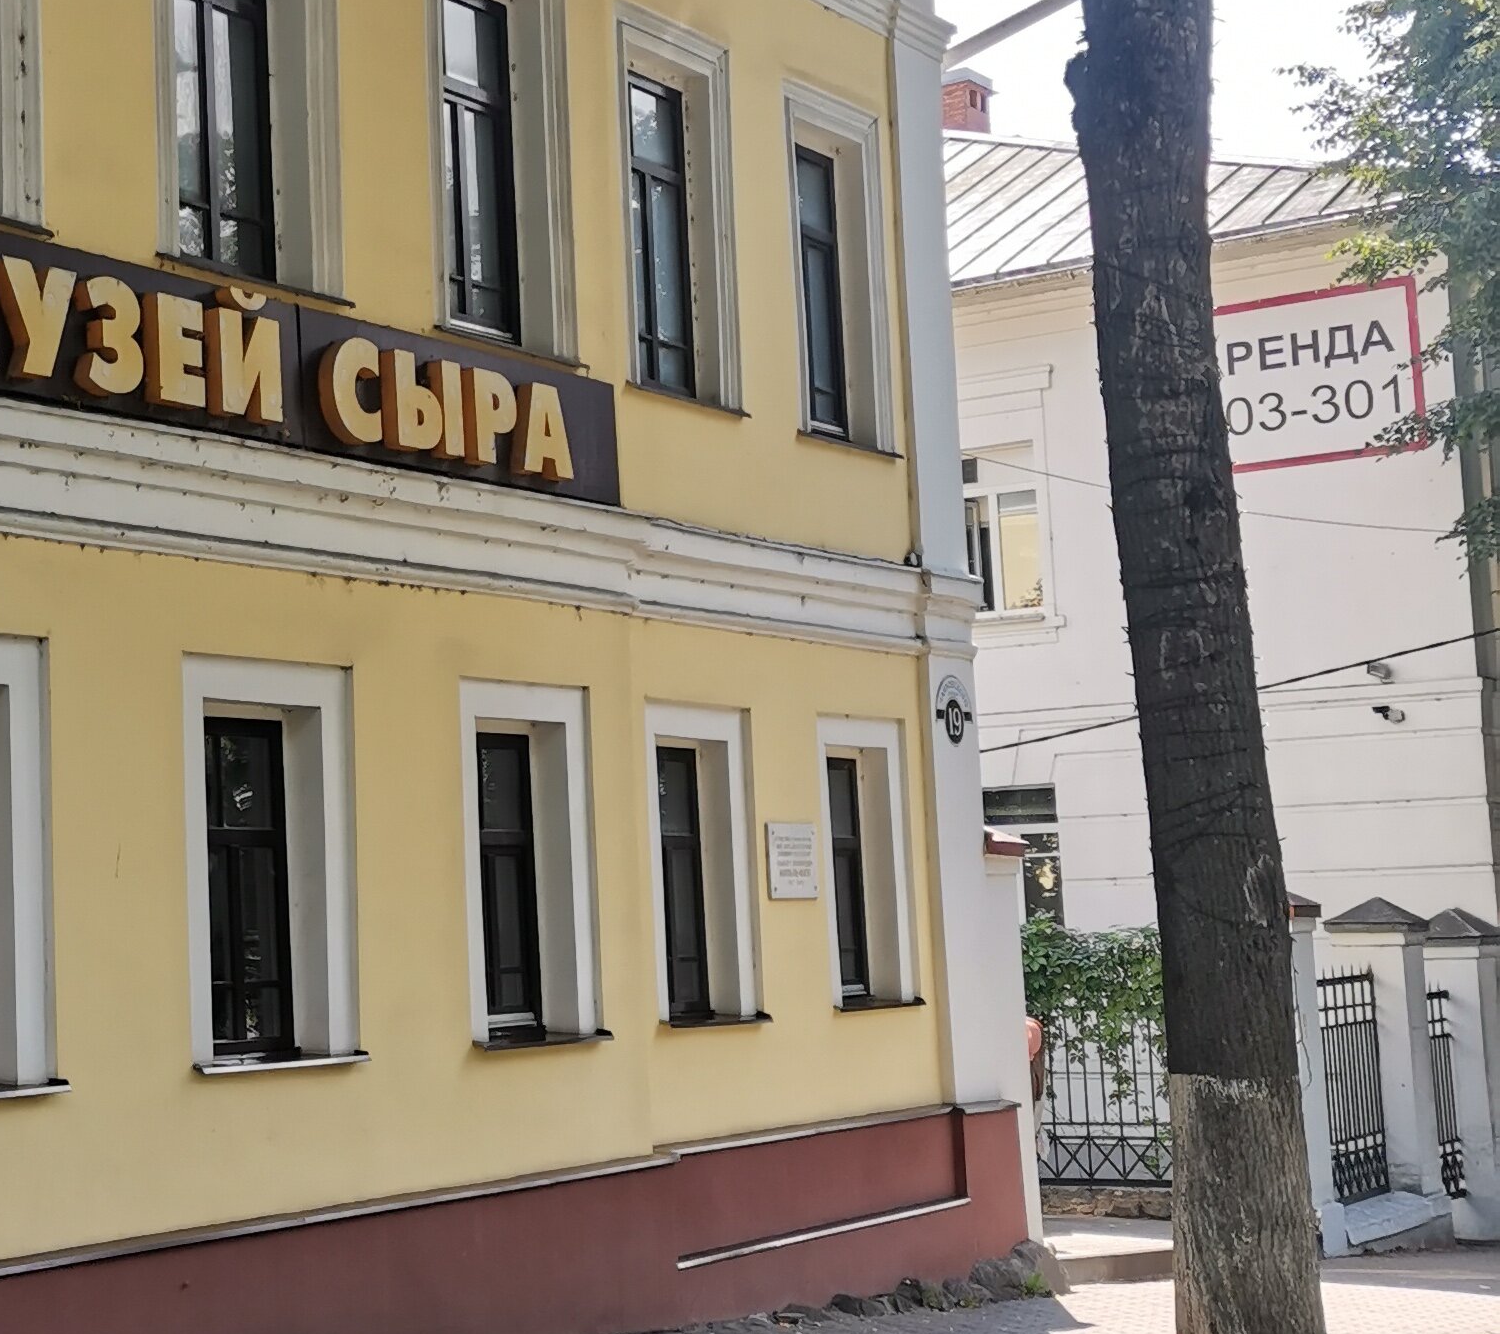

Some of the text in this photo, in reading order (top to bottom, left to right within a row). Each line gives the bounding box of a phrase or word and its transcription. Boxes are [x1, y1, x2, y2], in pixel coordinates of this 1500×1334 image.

[1226, 320, 1395, 376] РЕНДА
[318, 336, 574, 483] СЫРА
[1226, 374, 1401, 435] 03-301
[948, 707, 962, 736] 19
